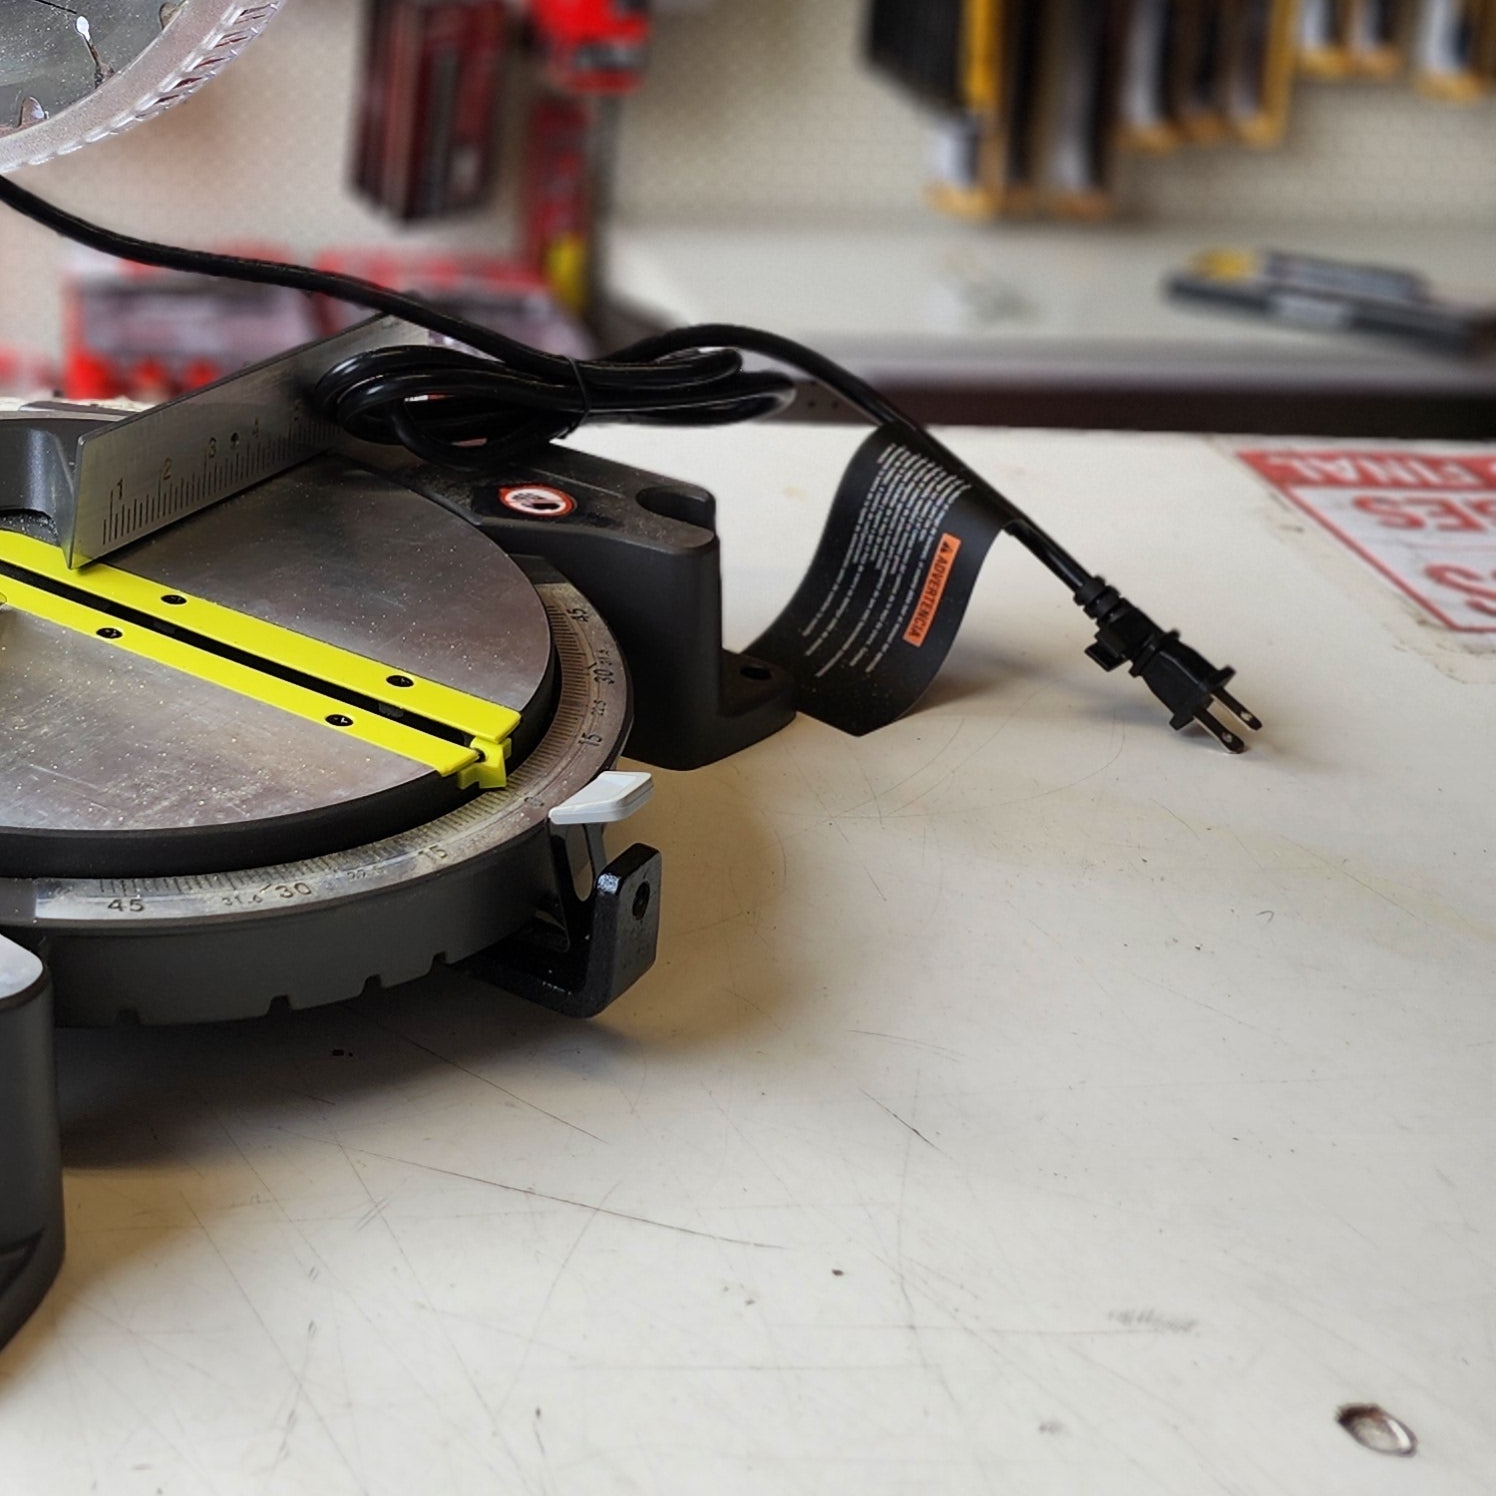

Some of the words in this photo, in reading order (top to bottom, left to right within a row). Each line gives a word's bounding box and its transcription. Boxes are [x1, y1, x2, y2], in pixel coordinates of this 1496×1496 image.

[208, 437, 217, 458] 3
[162, 457, 173, 480] 2
[1268, 457, 1486, 483] FINAL
[116, 478, 123, 499] 1
[908, 555, 947, 638] ADVERTENCIA
[594, 668, 615, 684] 30
[579, 732, 602, 748] 15
[278, 881, 312, 900] 30
[107, 898, 145, 913] 45
